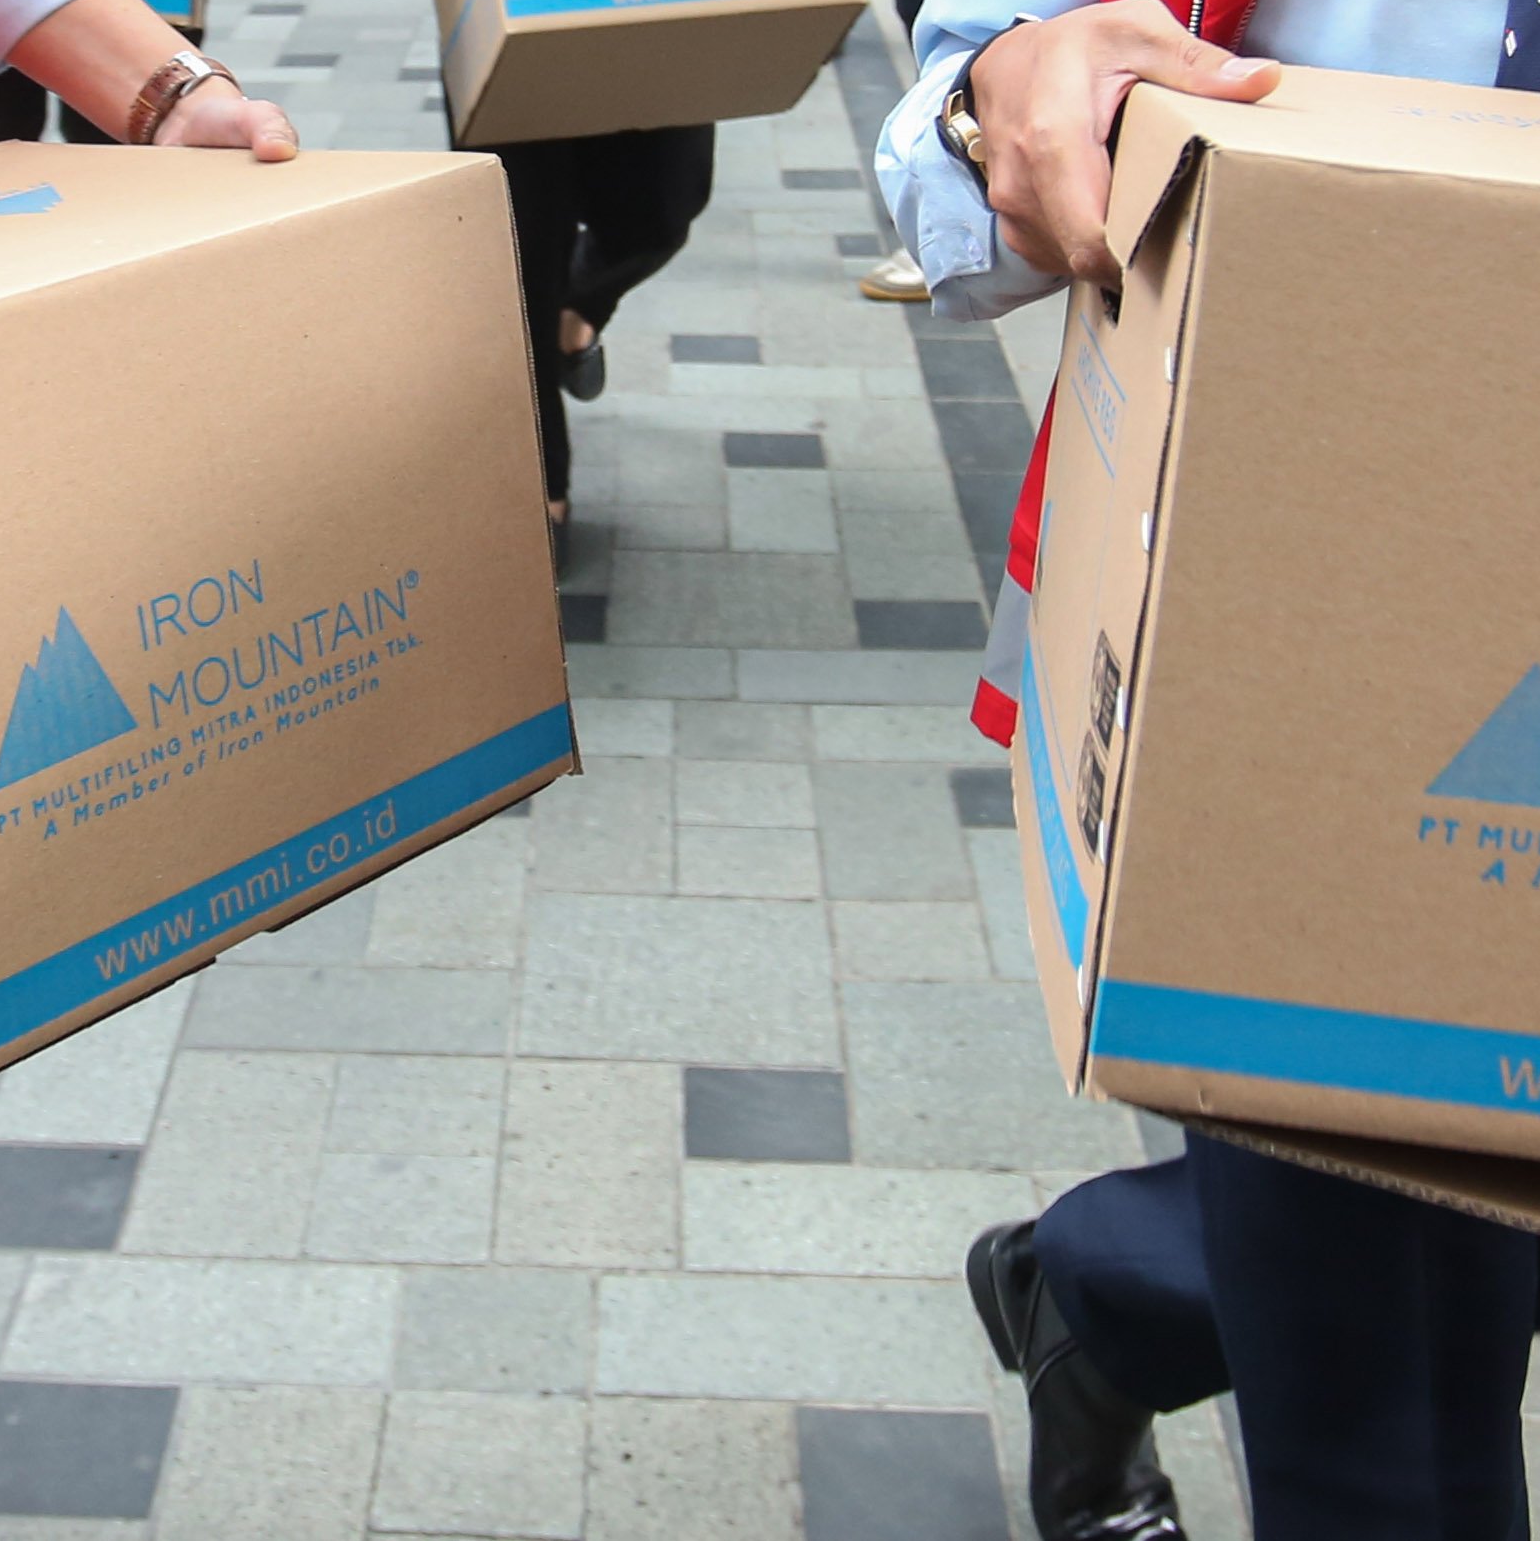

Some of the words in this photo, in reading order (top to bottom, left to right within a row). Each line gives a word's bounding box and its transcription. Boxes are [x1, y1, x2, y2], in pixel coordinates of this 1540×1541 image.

[137, 558, 264, 651] IRON
[32, 737, 181, 818] MULTIFILING
[191, 705, 257, 746] MITRA
[264, 650, 379, 713] INDONESIA
[385, 633, 424, 658] Tbk.
[43, 819, 58, 840] A
[72, 771, 170, 827] Member
[183, 749, 205, 776] of
[219, 730, 264, 760] Iron
[276, 677, 380, 733] Mountain
[93, 799, 397, 980] www.mmi.co.id
[1417, 815, 1461, 845] PT
[1481, 859, 1507, 885] A
